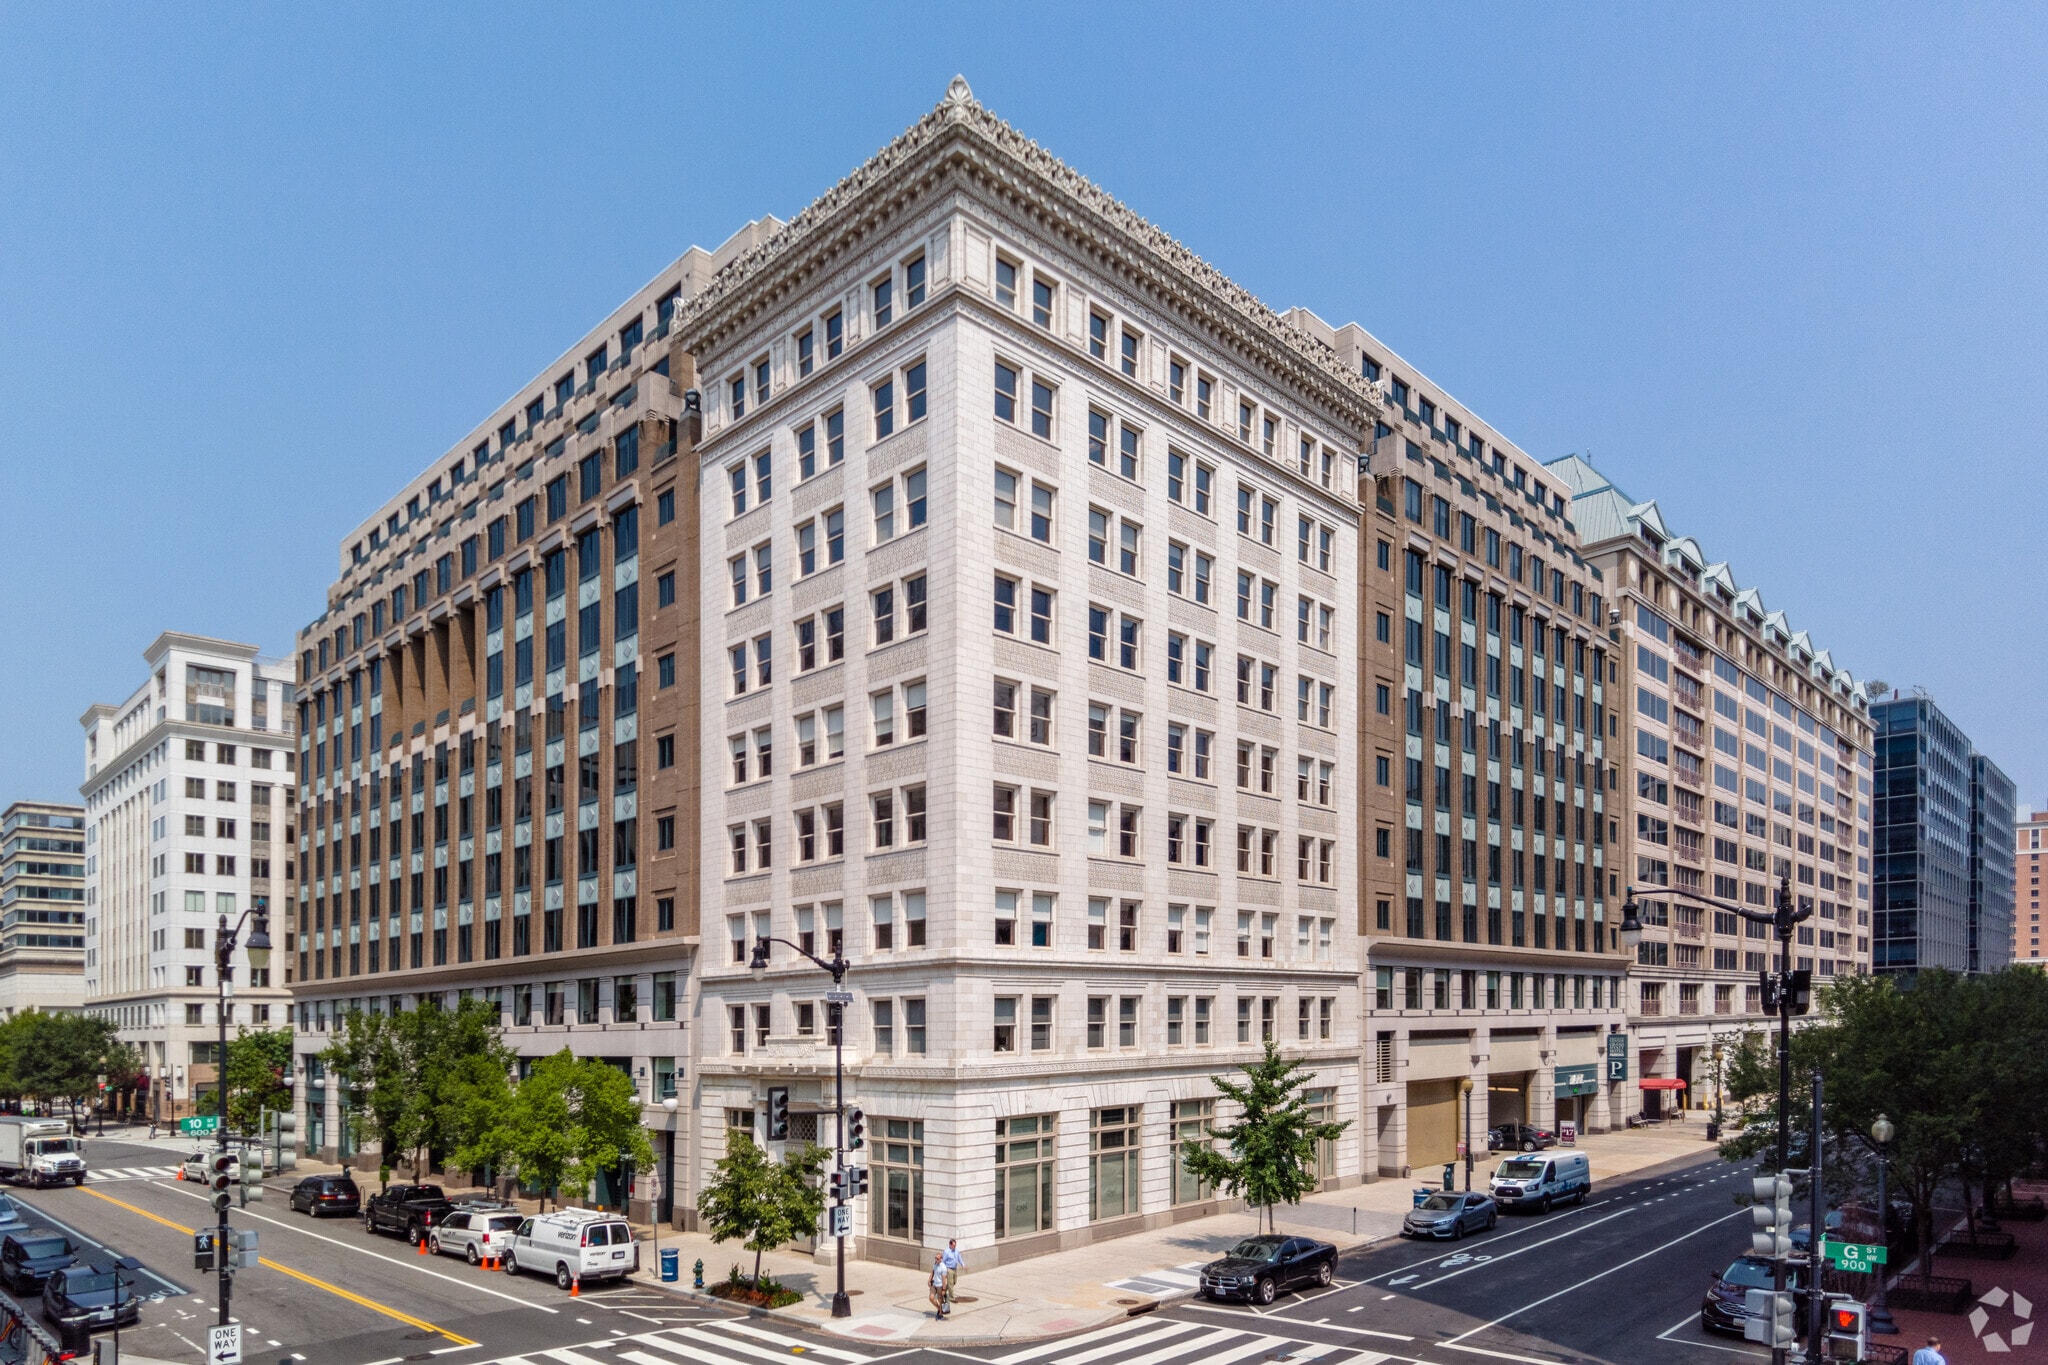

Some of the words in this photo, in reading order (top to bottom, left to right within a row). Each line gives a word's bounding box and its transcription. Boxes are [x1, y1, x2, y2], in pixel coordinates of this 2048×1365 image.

[1611, 1061, 1623, 1075] P
[188, 1119, 202, 1129] 10
[837, 1207, 849, 1216] ONE
[837, 1215, 849, 1224] WAY
[557, 1230, 577, 1240] verizon
[1843, 1245, 1858, 1259] G
[1866, 1246, 1877, 1254] ST
[1866, 1254, 1878, 1262] NW
[1841, 1259, 1866, 1271] 900
[215, 1328, 236, 1339] ONE
[214, 1338, 237, 1349] WAY
